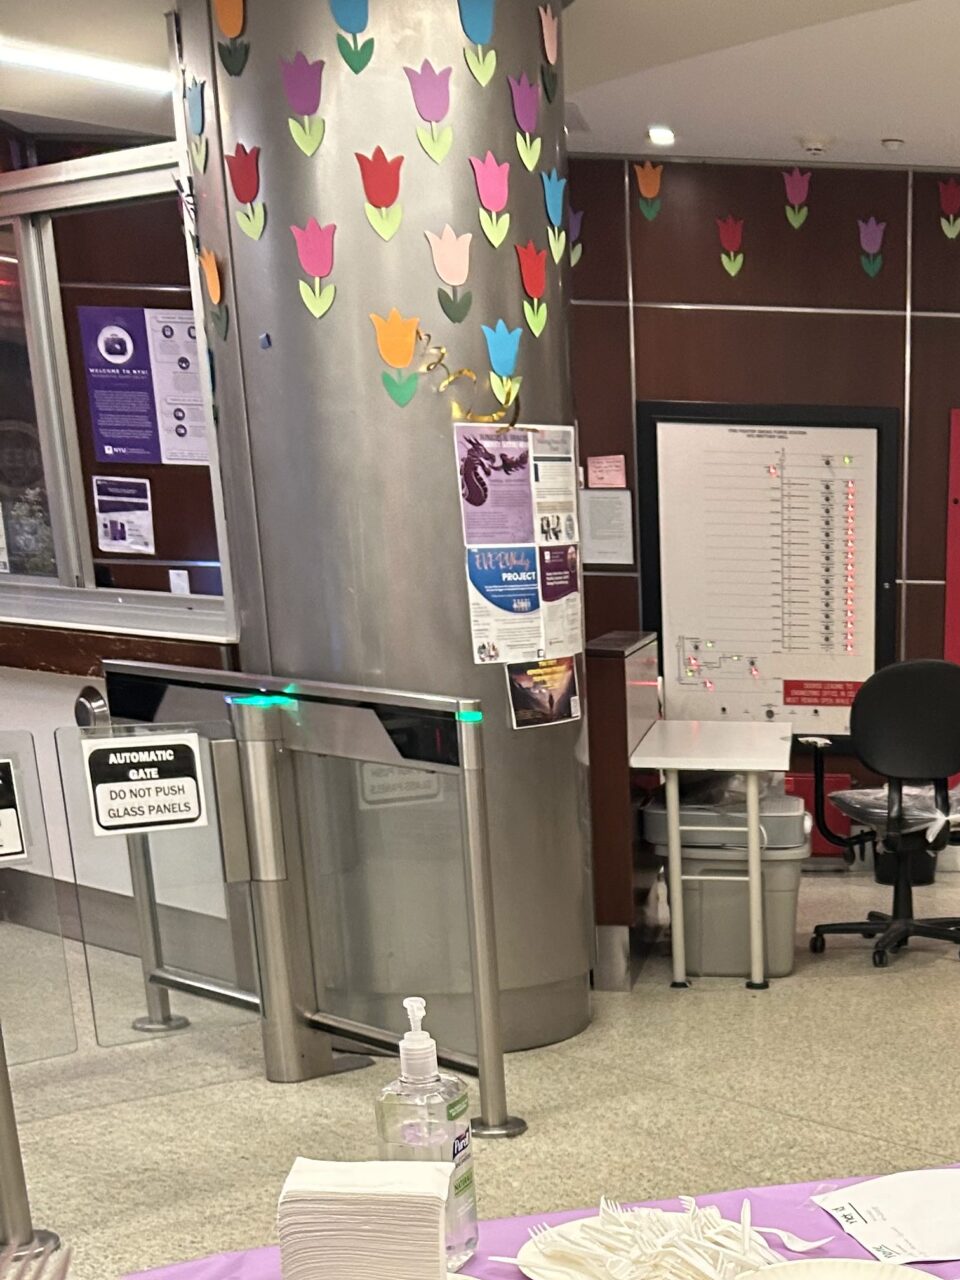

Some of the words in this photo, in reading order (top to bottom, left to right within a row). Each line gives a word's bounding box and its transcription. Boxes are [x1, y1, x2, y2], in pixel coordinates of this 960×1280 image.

[89, 367, 120, 375] WELCOME
[113, 446, 127, 454] NYU
[502, 571, 537, 582] PROJECT
[109, 750, 174, 764] AUTOMATIC
[129, 768, 158, 780] GATE
[109, 788, 126, 801] DO
[129, 787, 152, 799] NOT
[155, 784, 186, 797] PUSH
[107, 805, 145, 819] GLASS
[148, 802, 191, 815] PANELS
